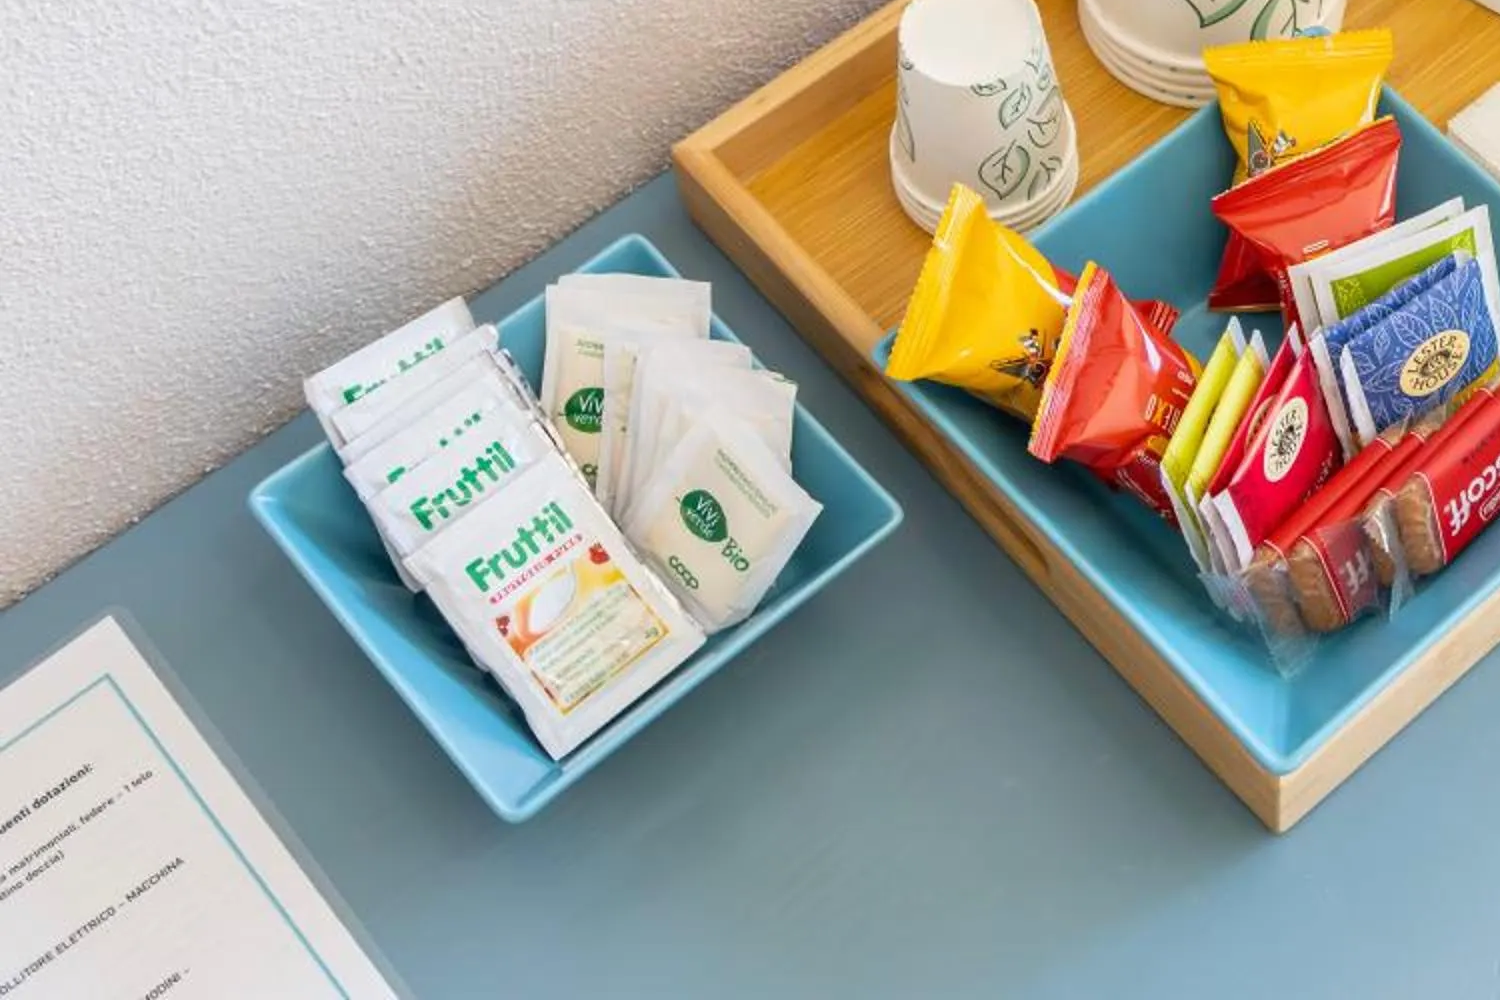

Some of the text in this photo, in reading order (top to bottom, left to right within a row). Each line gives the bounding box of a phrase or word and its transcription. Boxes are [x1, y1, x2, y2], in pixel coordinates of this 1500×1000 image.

[1407, 335, 1457, 374] LESTER
[410, 441, 515, 530] Fruttil
[465, 501, 574, 592] Fruttil
[55, 905, 117, 956] ELETTRICO
[125, 857, 185, 902] MACCHINA
